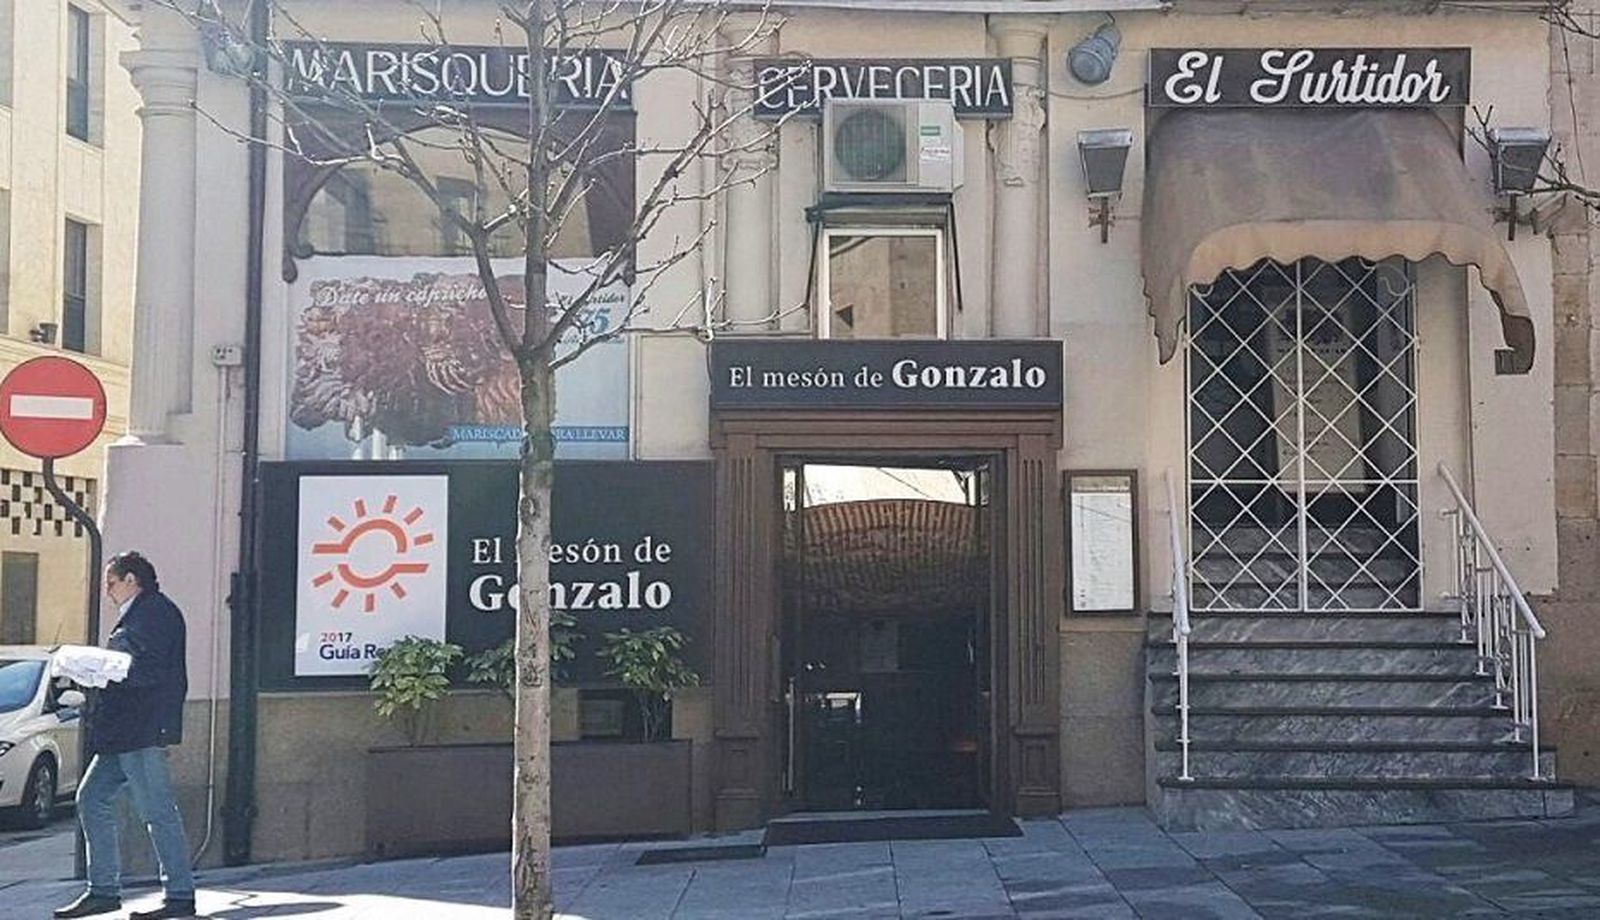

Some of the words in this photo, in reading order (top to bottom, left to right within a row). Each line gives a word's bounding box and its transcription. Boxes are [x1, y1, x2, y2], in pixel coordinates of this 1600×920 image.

[288, 50, 628, 99] MARISQUERIA
[758, 65, 1009, 109] CERVECERIA
[1164, 51, 1224, 104] El
[1250, 49, 1451, 104] Surtidor
[729, 366, 752, 388] El
[763, 367, 845, 388] mesón
[854, 367, 883, 388] de
[892, 358, 1046, 389] Gonzalo
[453, 429, 524, 440] MARISCAD
[472, 537, 503, 564] El
[516, 538, 623, 564] esón
[634, 536, 672, 563] de
[320, 632, 352, 643] 2017
